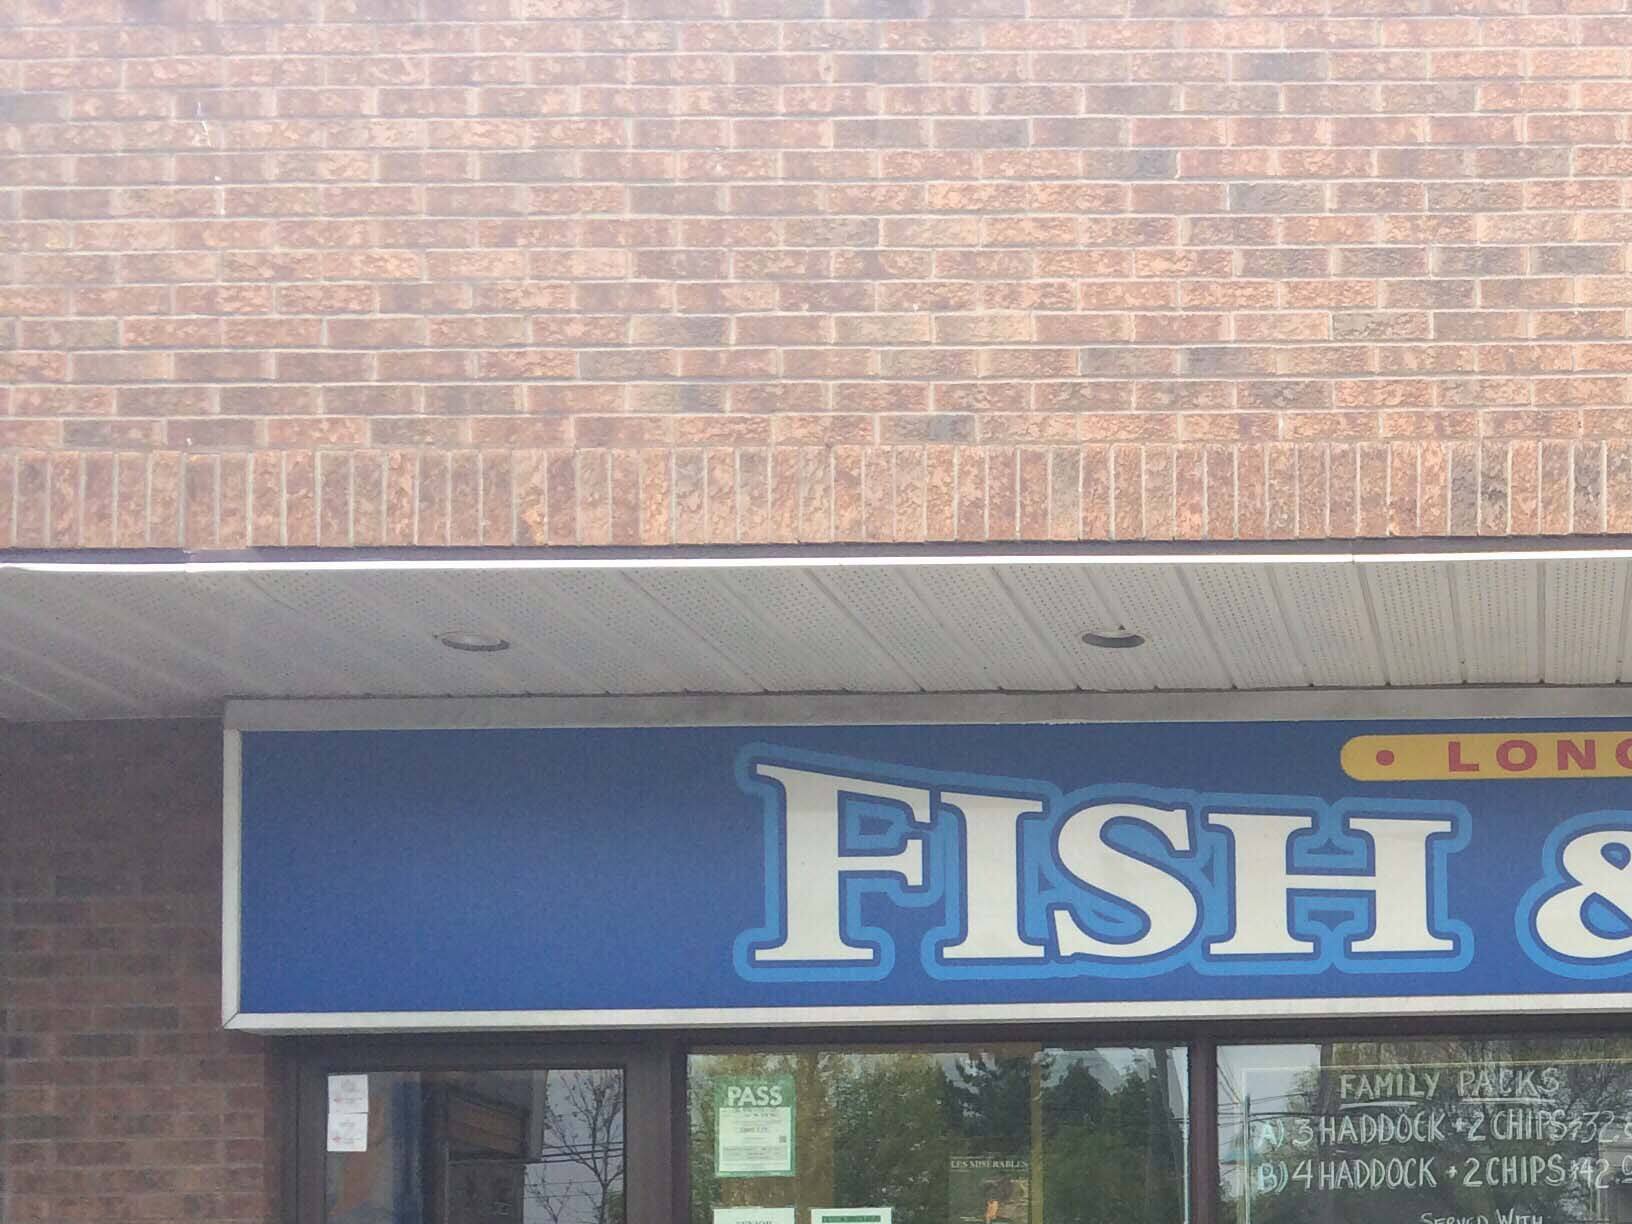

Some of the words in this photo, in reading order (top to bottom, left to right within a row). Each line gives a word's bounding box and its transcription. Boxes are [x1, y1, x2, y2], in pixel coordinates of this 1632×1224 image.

[755, 762, 1455, 961] FISH
[727, 1085, 783, 1107] PASS
[1340, 1072, 1440, 1100] FAMILY
[1457, 1067, 1560, 1098] PACKS
[1319, 1111, 1446, 1145] HADDOCK
[1468, 1111, 1487, 1142] 2
[1491, 1109, 1568, 1141] CHIPS
[1319, 1156, 1438, 1190] HADDOCK
[1463, 1157, 1483, 1188] 2
[1486, 1153, 1566, 1187] CHIPS
